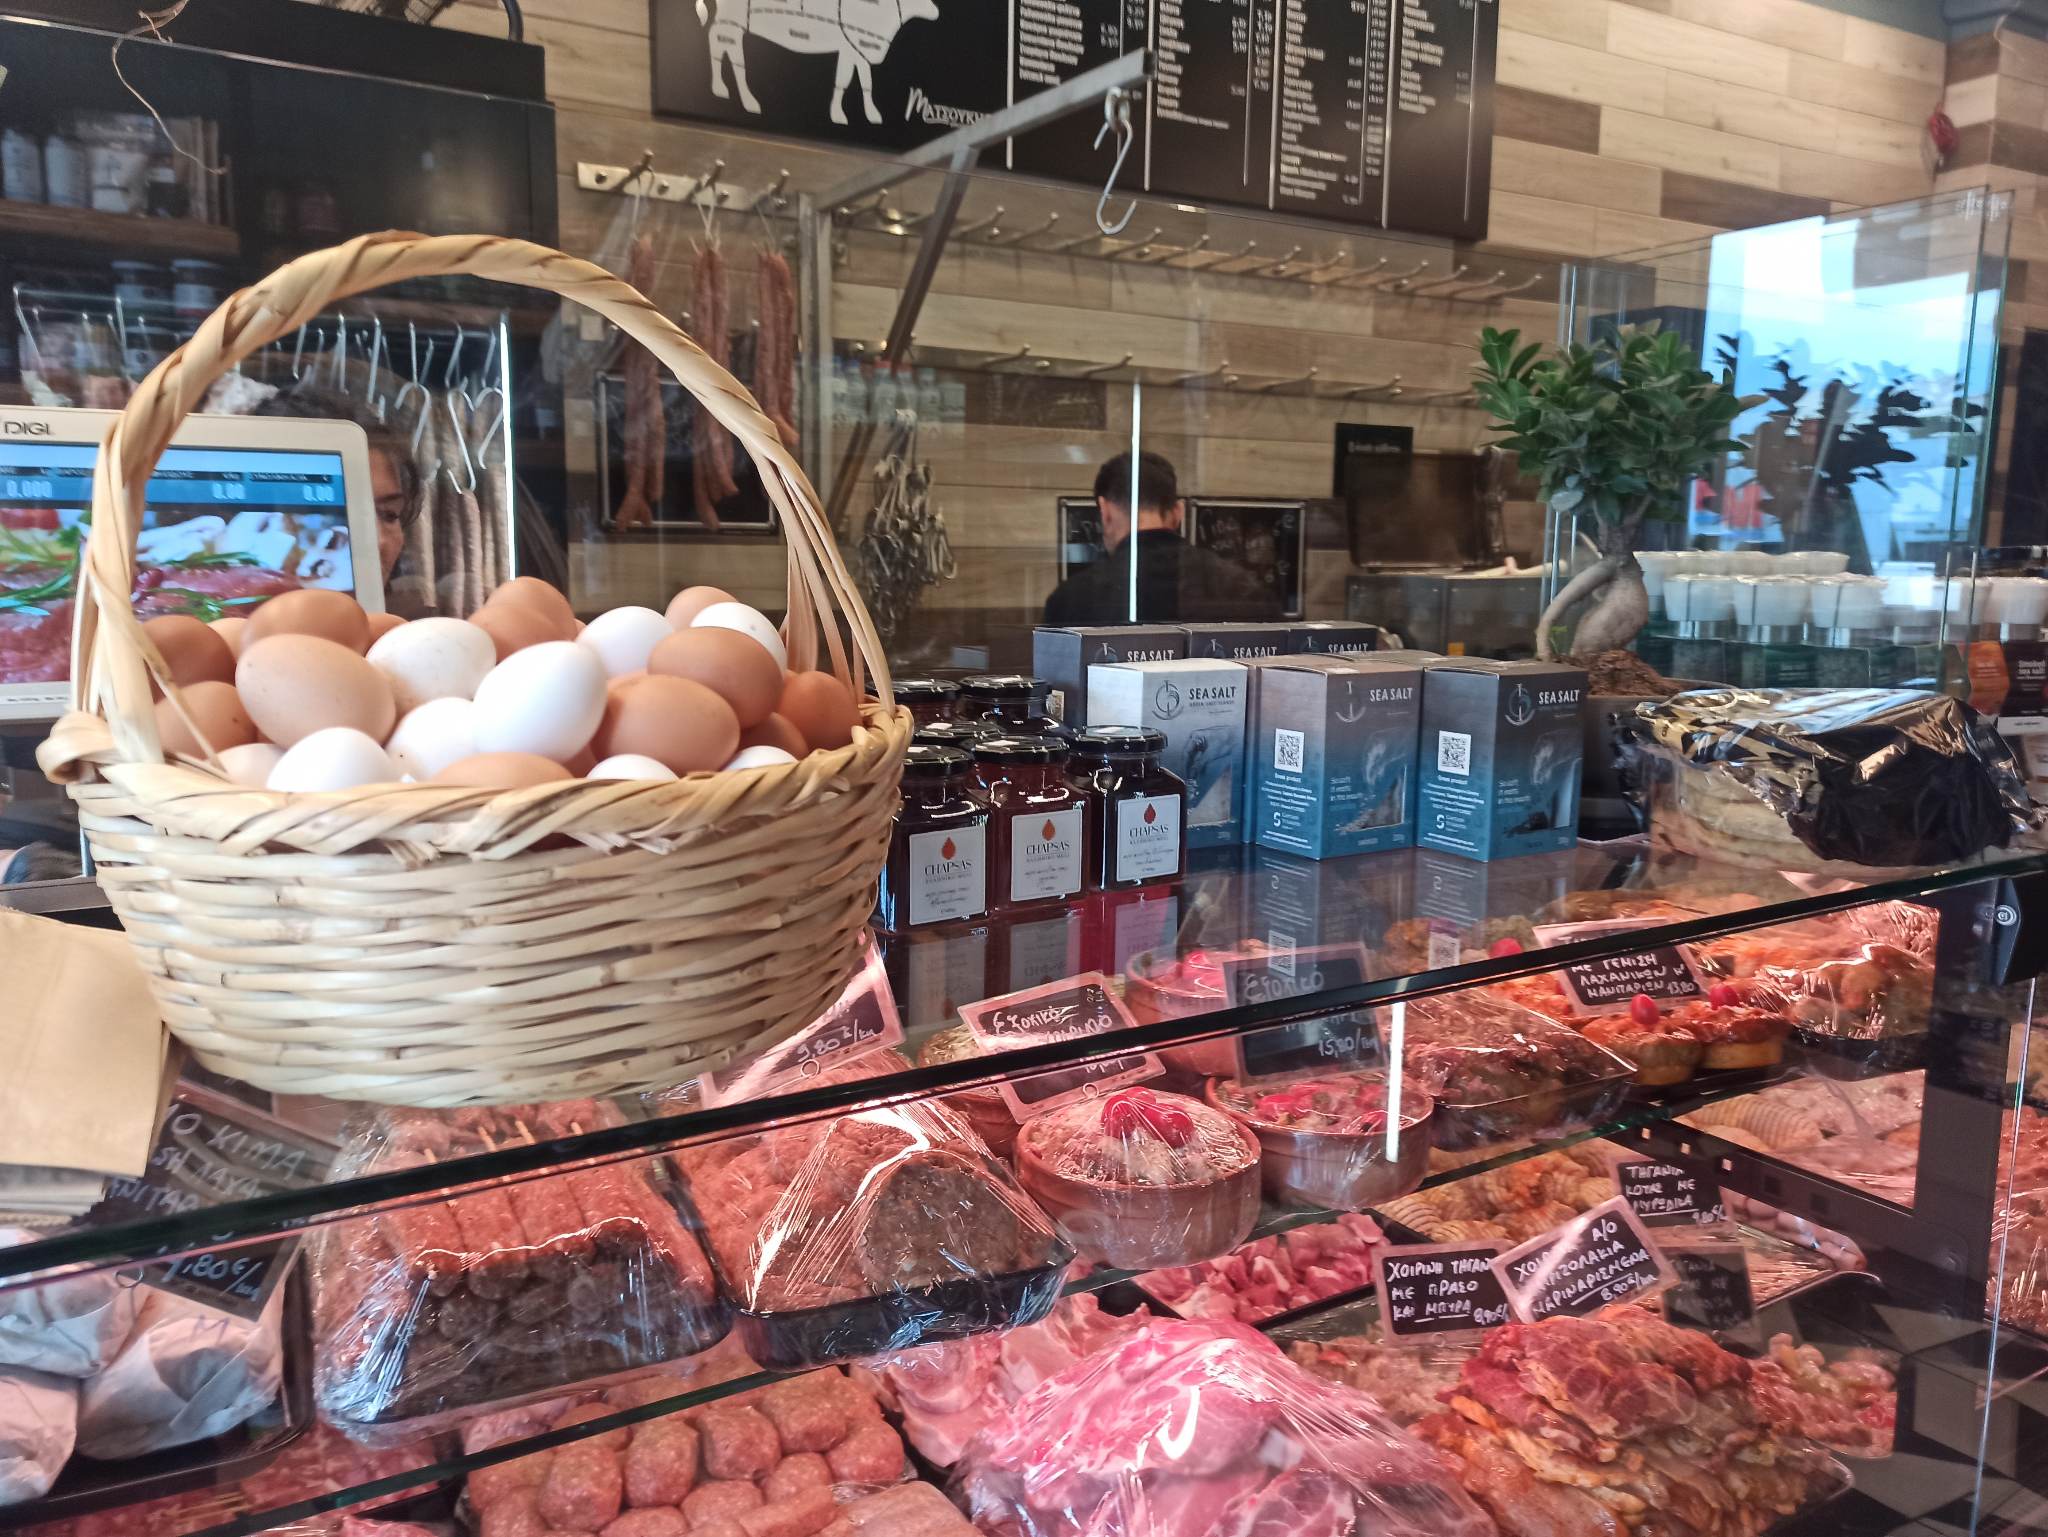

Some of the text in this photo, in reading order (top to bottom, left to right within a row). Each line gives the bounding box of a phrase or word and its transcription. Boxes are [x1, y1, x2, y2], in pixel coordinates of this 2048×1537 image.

[1233, 646, 1278, 659] SEA SALT
[1327, 642, 1369, 654] SEA SALT
[1127, 649, 1175, 662] SEA SALT
[1189, 686, 1237, 700] SEA SALT
[1369, 687, 1413, 702] SEA SALT
[1538, 689, 1580, 705] SEA SALT
[1129, 824, 1169, 838] CHAPSAS
[1026, 840, 1070, 855] CHAPSAS
[924, 860, 972, 876] CHAPSAS
[1451, 1258, 1491, 1274] ΤΗΓΑΝ
